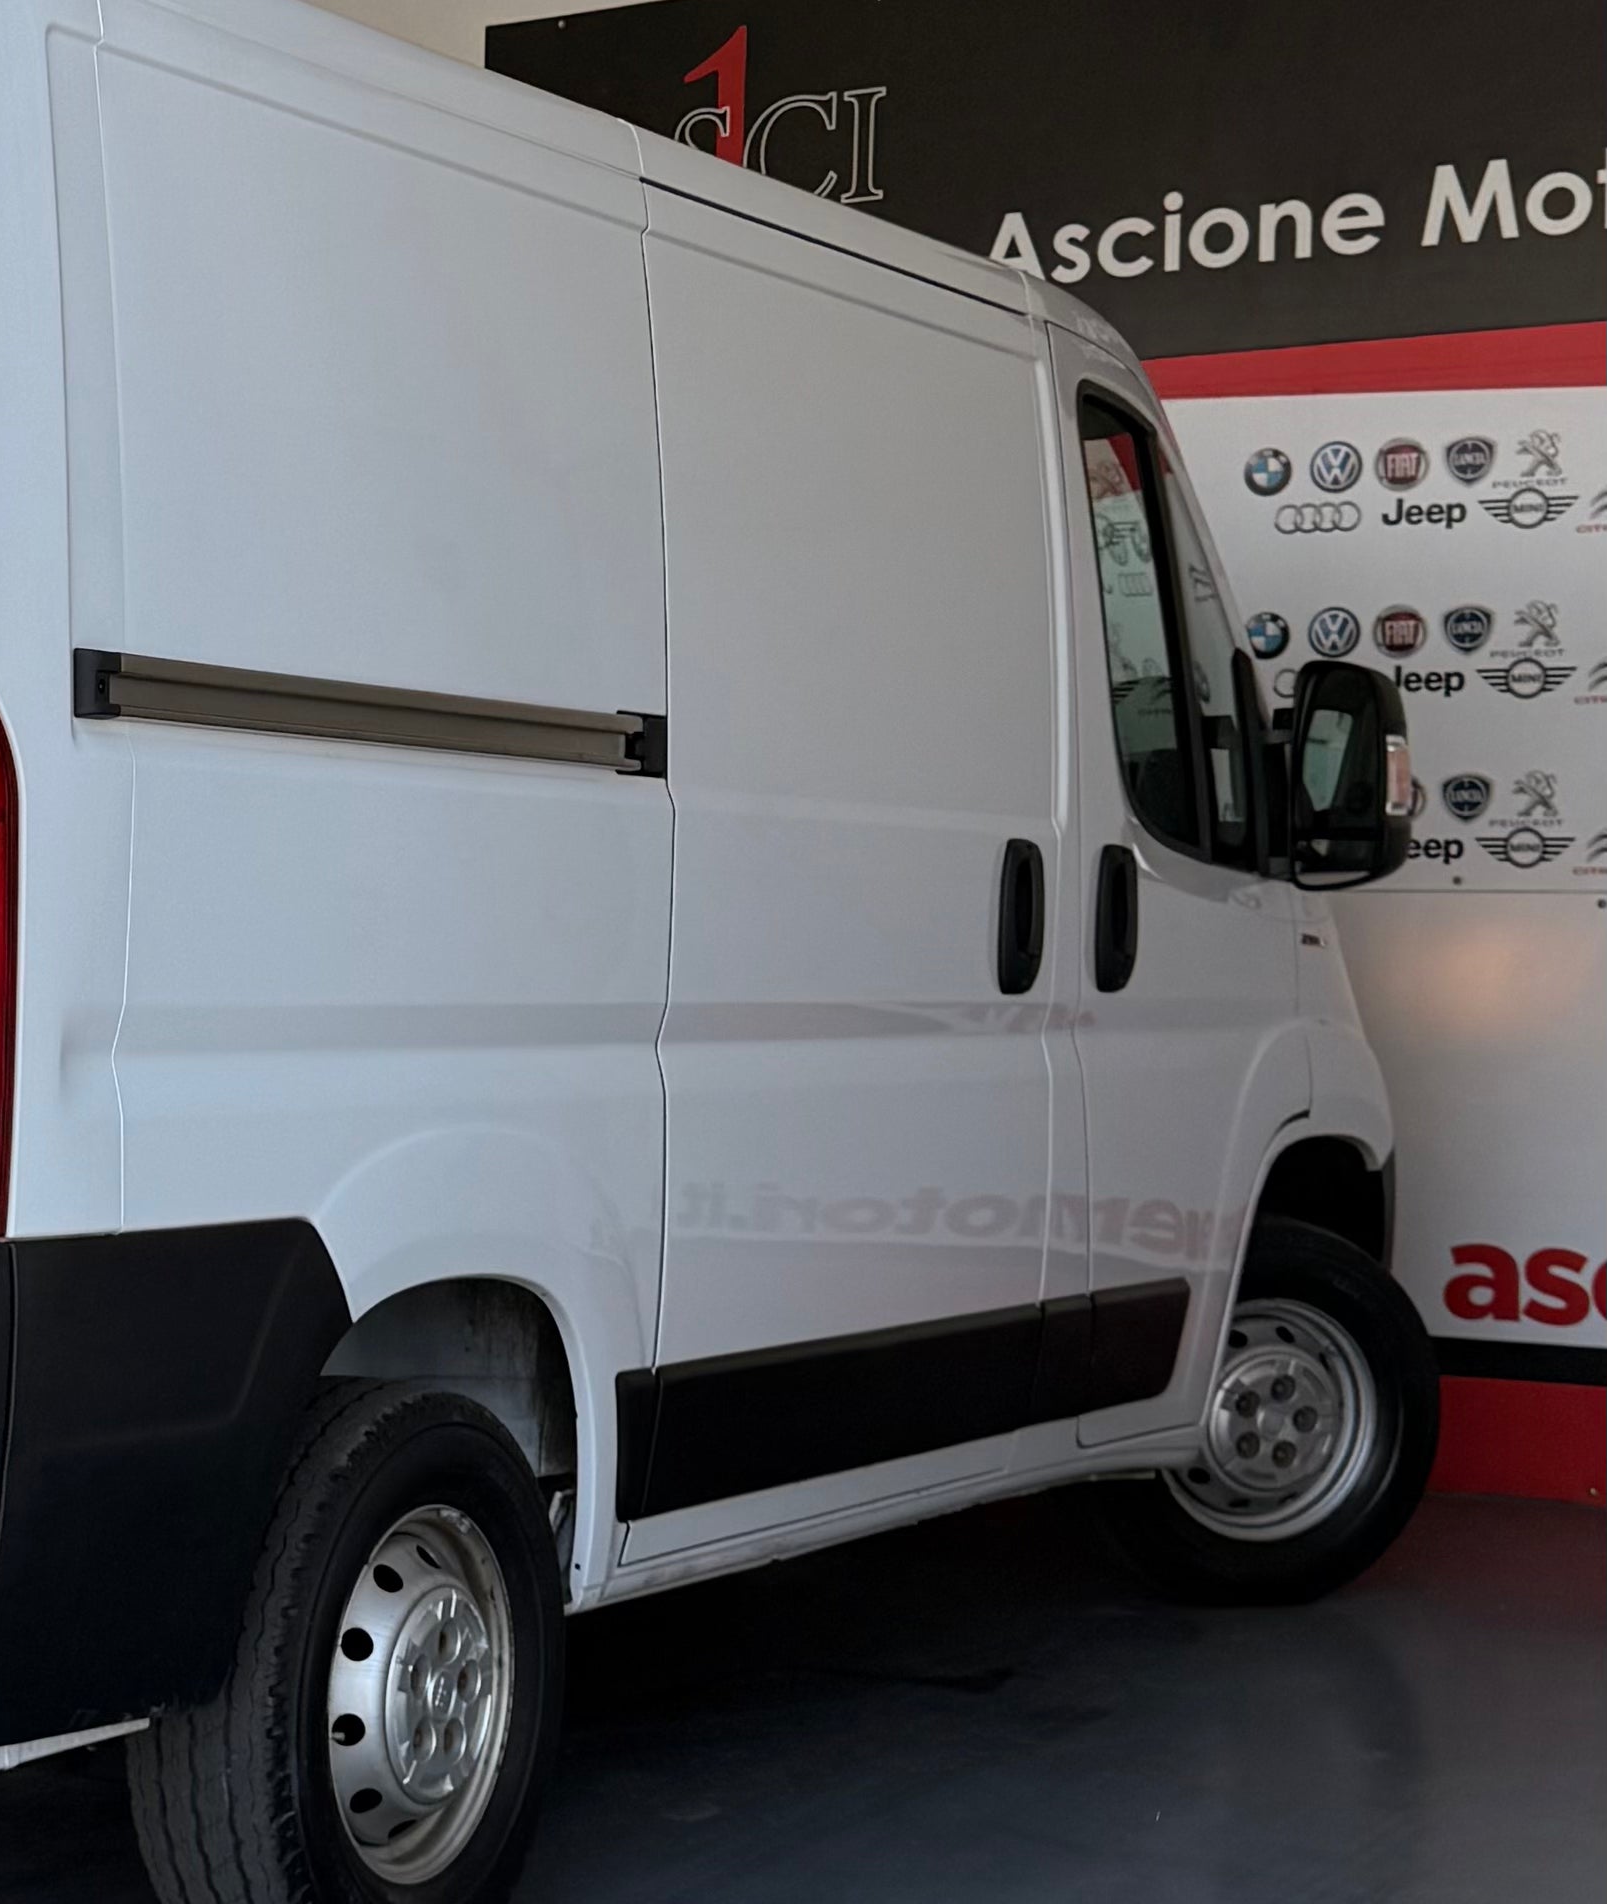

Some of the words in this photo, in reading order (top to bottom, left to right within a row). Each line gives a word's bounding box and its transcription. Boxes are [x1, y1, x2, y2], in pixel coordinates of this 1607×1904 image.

[989, 190, 1386, 284] Ascione
[1386, 452, 1420, 479] FIAT
[1381, 497, 1467, 529] Jeep
[1407, 838, 1465, 865] eep
[1443, 1243, 1607, 1327] as
